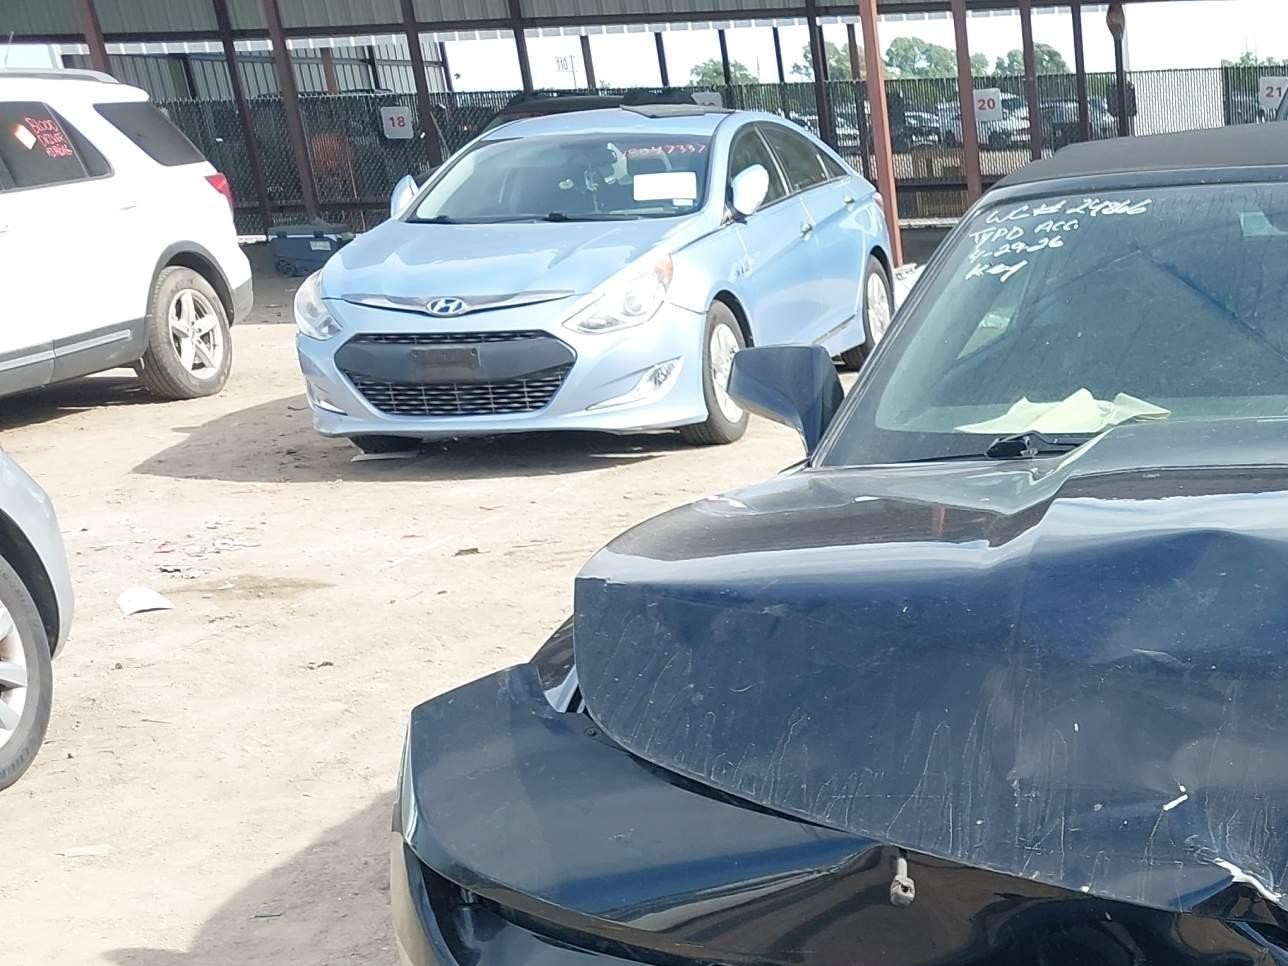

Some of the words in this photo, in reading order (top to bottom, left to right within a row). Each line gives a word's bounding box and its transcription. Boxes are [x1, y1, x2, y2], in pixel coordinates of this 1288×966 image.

[1265, 86, 1282, 98] 21
[977, 98, 996, 110] 20
[389, 115, 406, 128] 18
